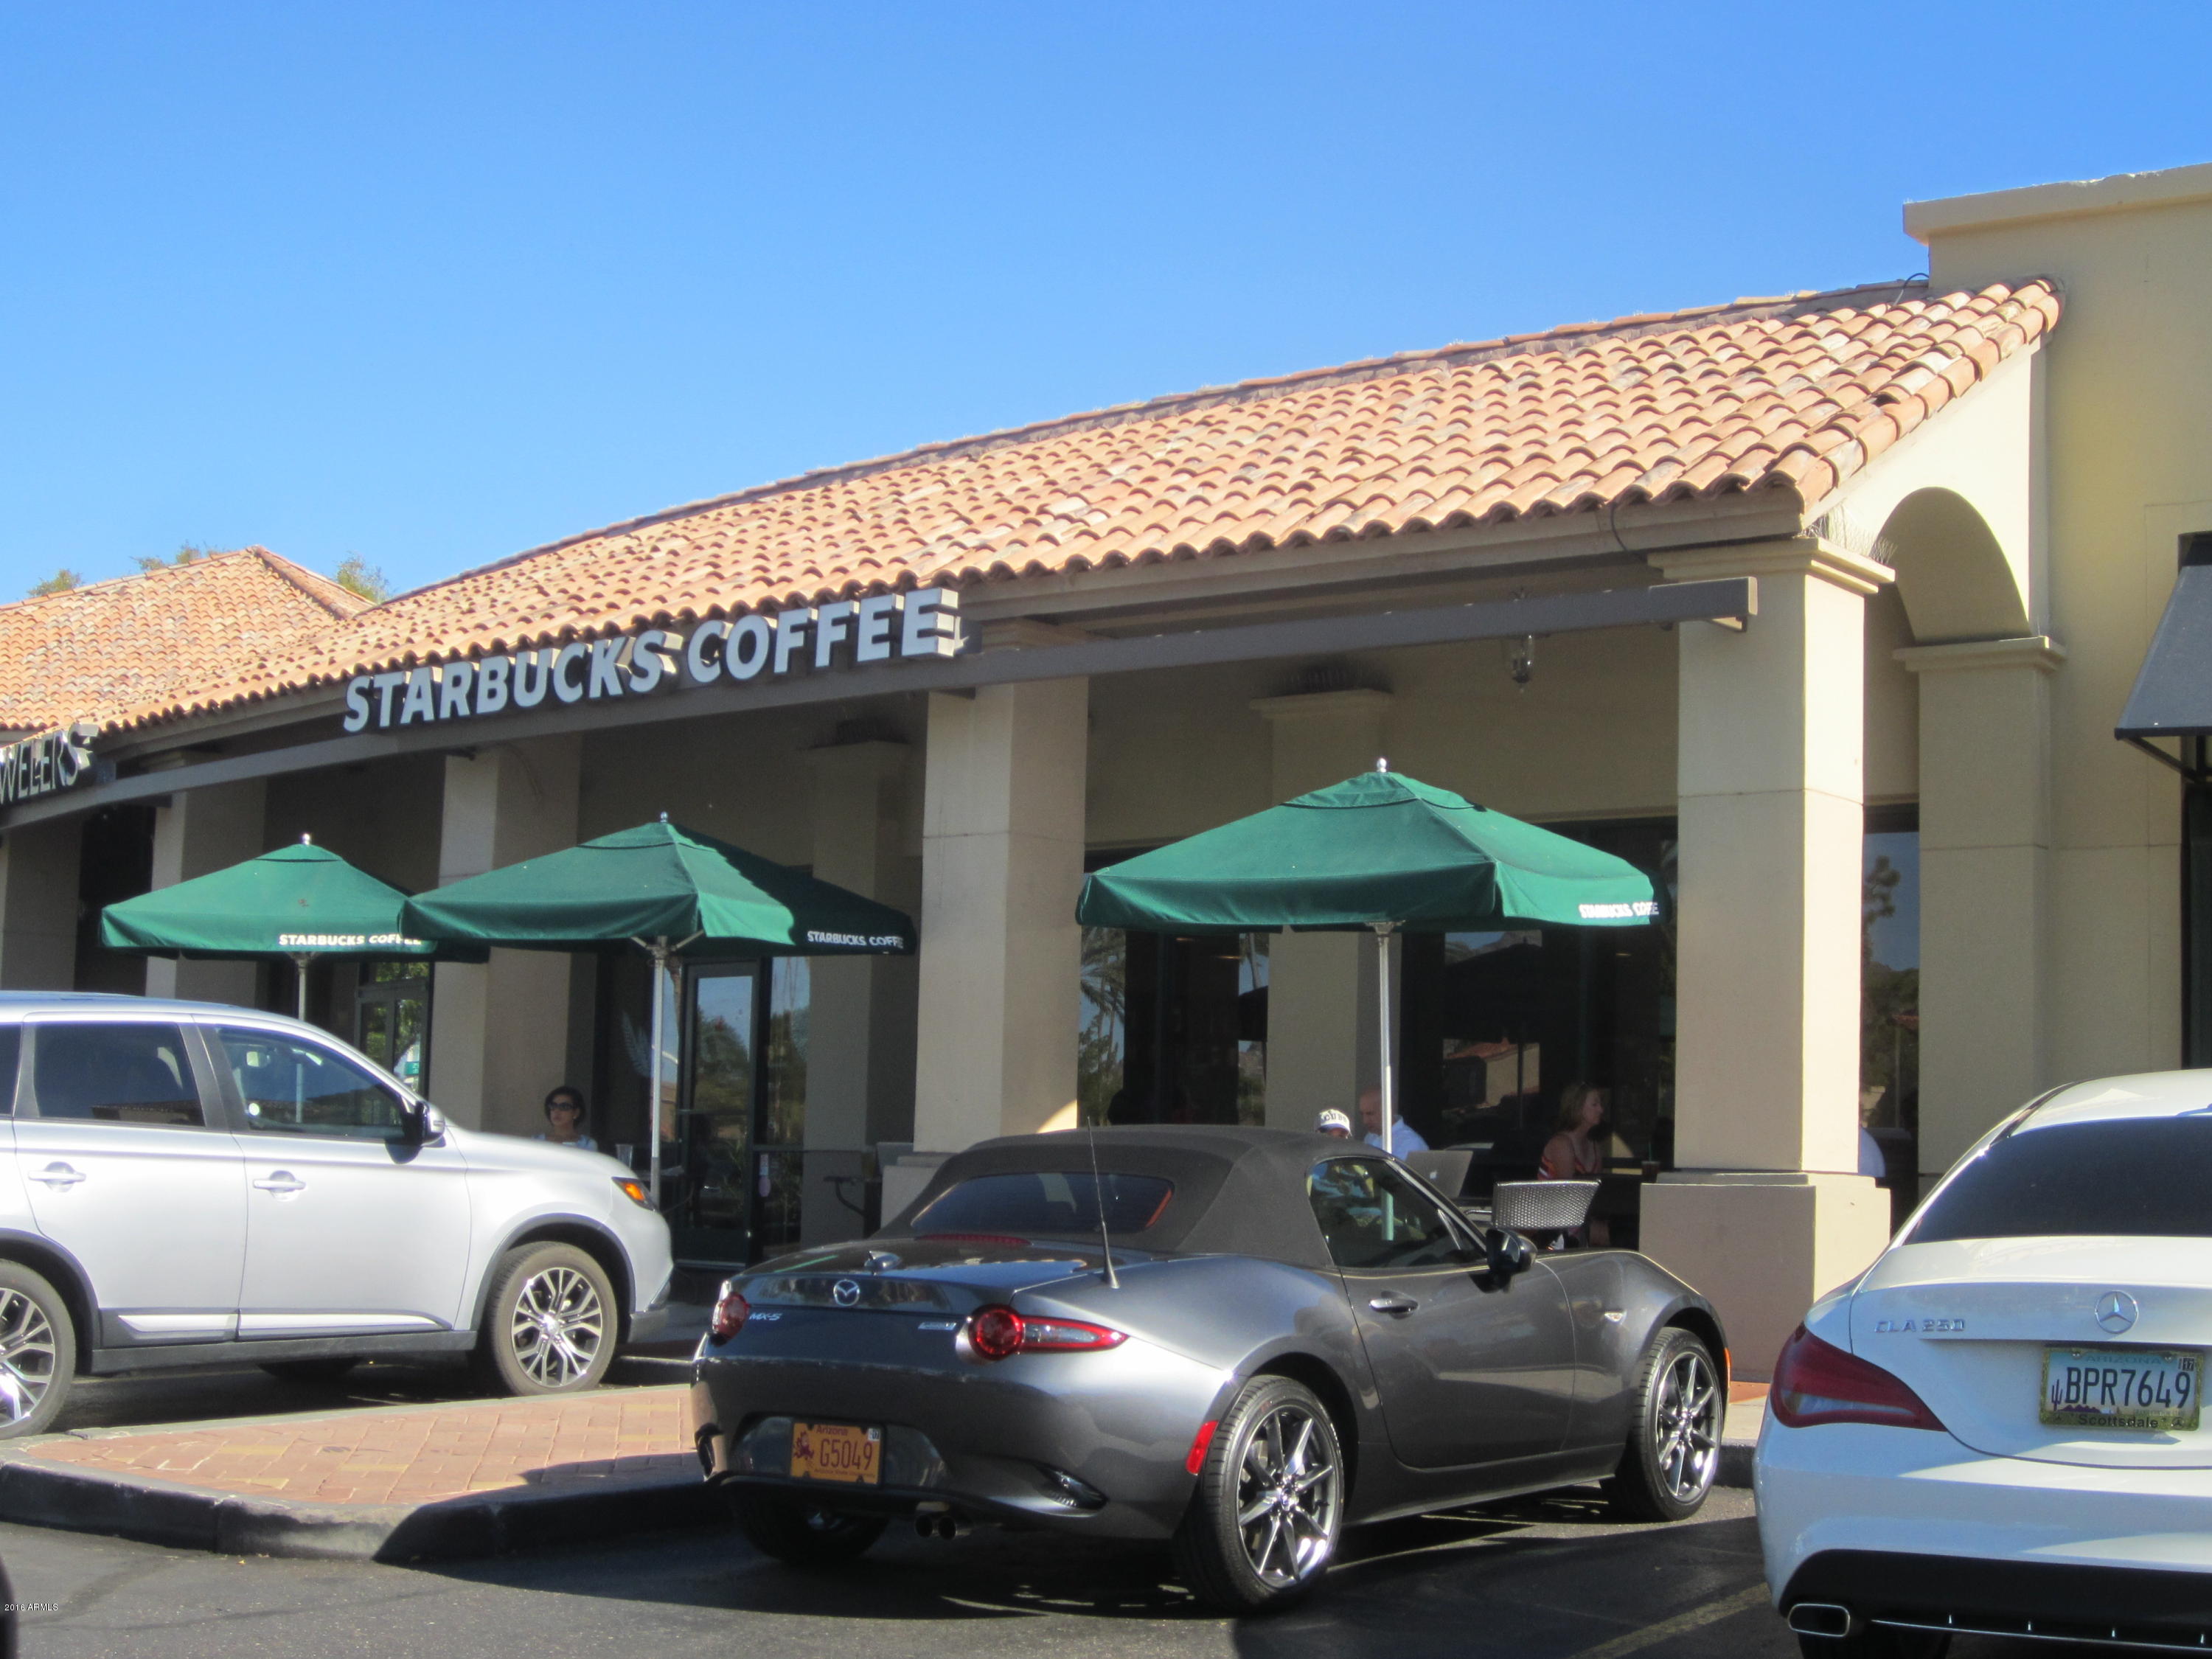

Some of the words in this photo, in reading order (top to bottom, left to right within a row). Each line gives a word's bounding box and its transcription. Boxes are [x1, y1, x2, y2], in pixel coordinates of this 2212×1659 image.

[343, 629, 684, 733] STARBUCKS
[687, 588, 959, 684] COFFEE
[279, 933, 366, 946] STARBUCKS
[807, 931, 868, 947] STARBUCKS
[749, 1312, 782, 1321] MX-5
[1874, 1320, 1917, 1333] CLA
[1922, 1318, 1965, 1332] 250
[2085, 1355, 2161, 1365] ARIZONA
[2065, 1366, 2191, 1409] BPR7649
[2078, 1413, 2159, 1429] Scottsdale
[816, 1425, 849, 1436] Arizona
[820, 1438, 873, 1470] G5049
